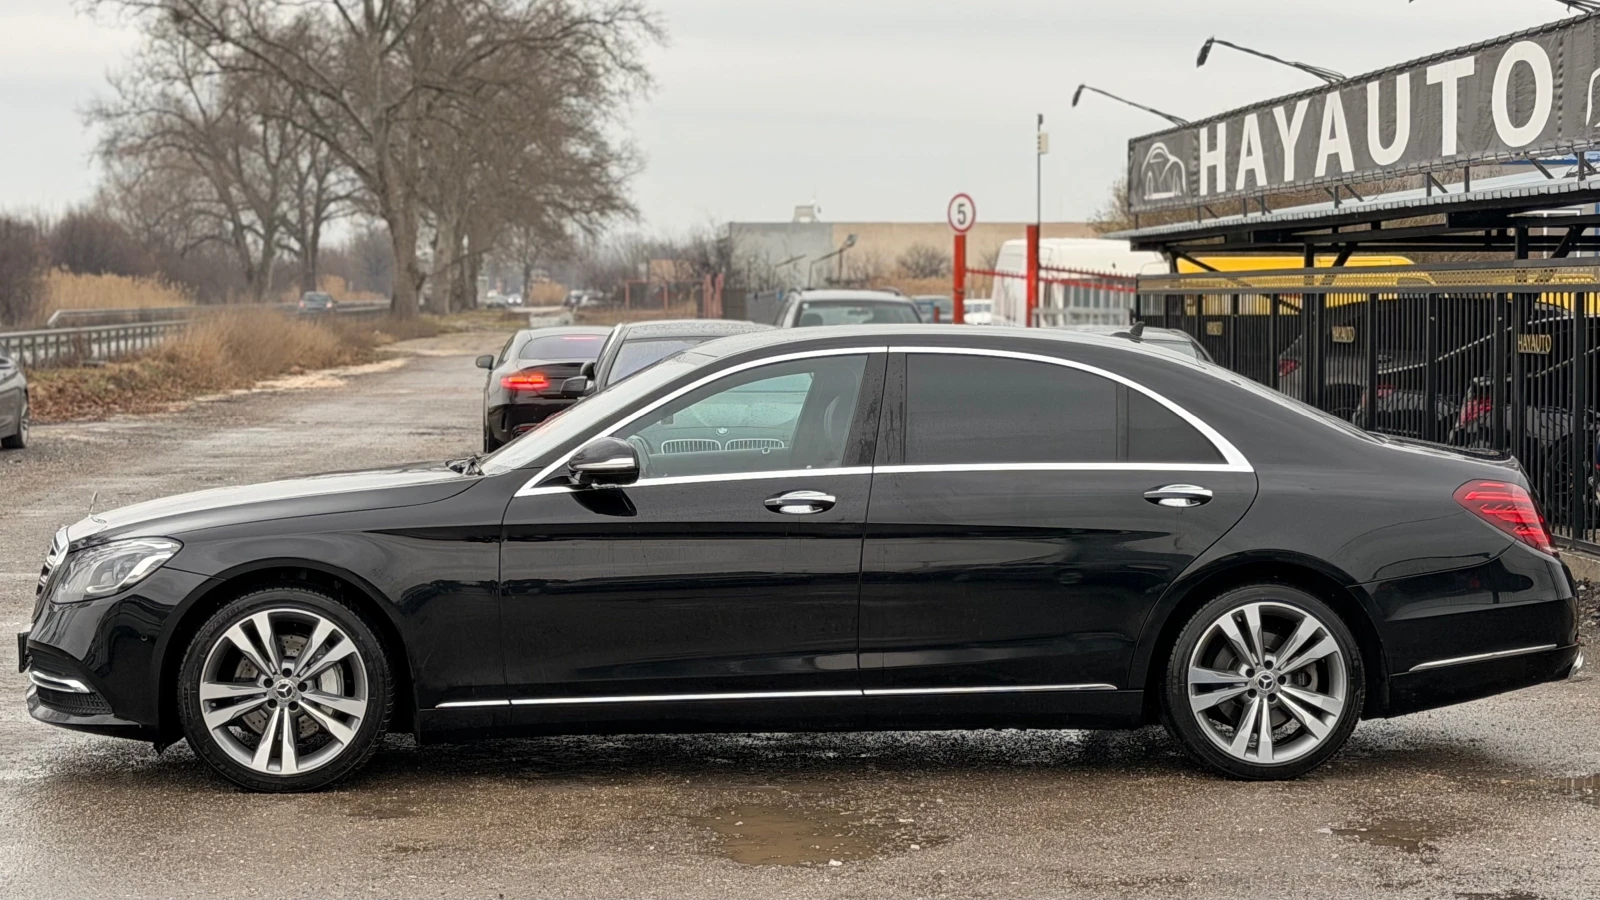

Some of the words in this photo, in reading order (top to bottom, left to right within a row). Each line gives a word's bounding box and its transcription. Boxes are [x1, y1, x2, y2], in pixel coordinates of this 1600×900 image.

[1199, 40, 1554, 197] HAYAUTO
[957, 203, 967, 226] 5
[1517, 334, 1552, 354] HAYAUTO
